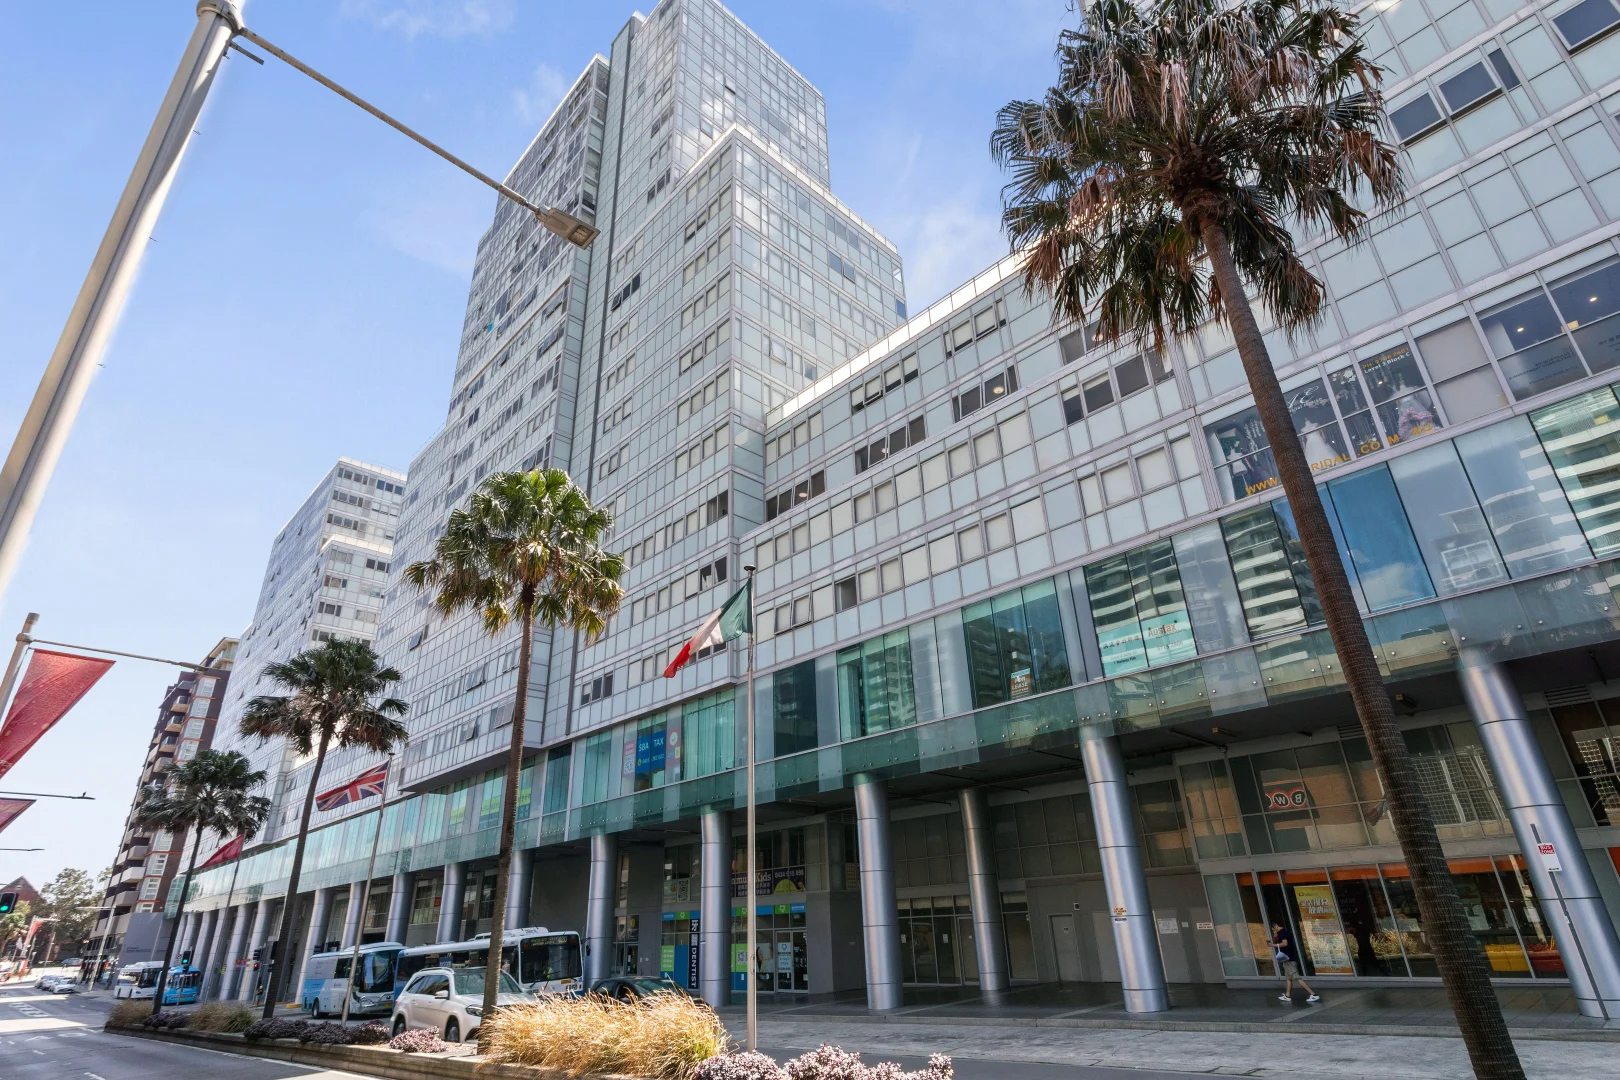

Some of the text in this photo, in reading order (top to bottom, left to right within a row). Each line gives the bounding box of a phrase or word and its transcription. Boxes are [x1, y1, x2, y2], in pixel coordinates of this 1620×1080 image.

[1364, 364, 1381, 374] Level
[1387, 354, 1405, 365] Block
[639, 742, 650, 752] SBA
[654, 738, 664, 747] TAX
